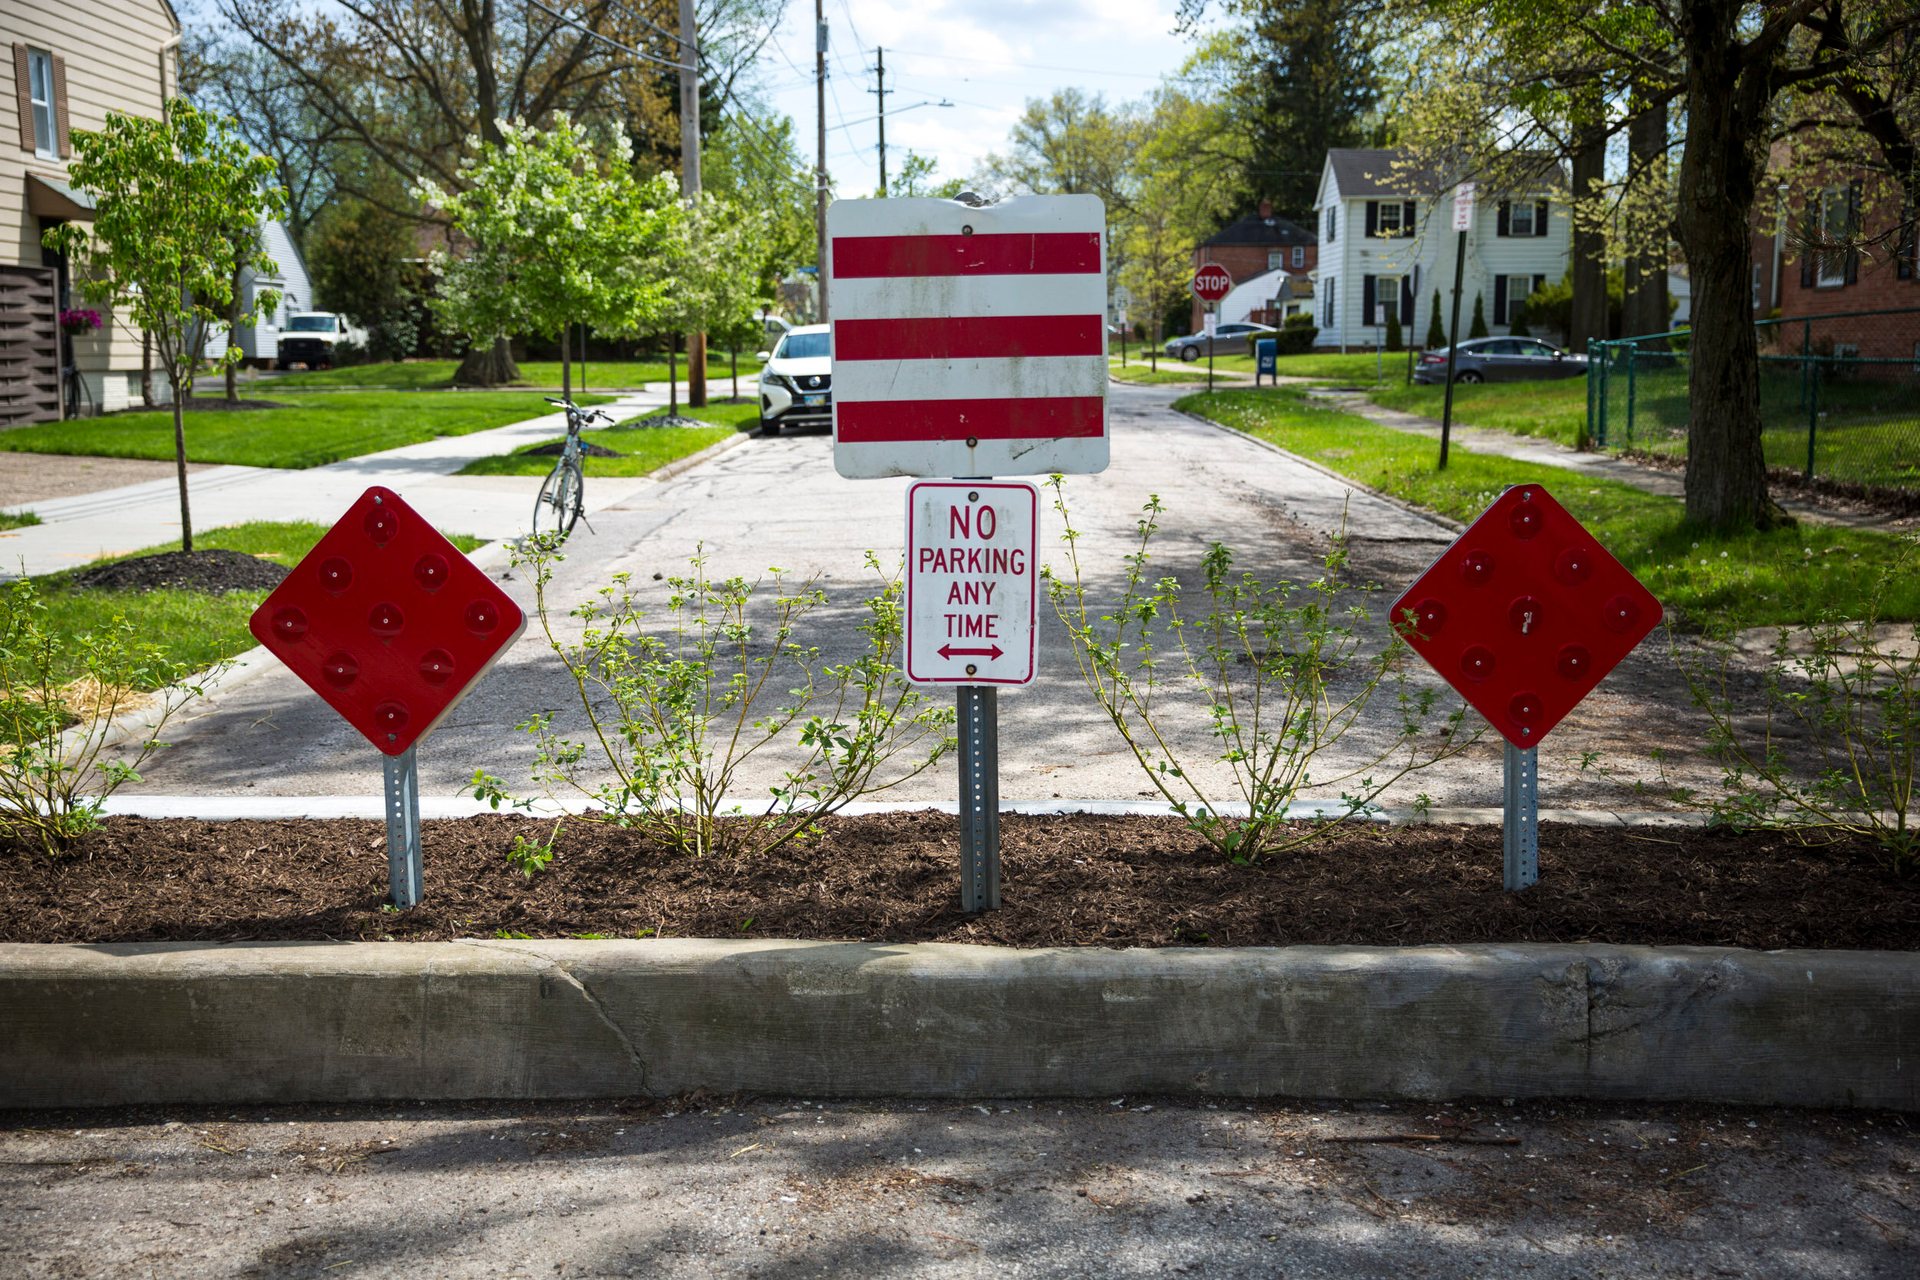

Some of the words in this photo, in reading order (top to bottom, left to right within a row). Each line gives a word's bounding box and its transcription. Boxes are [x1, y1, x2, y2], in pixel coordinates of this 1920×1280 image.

[1195, 275, 1228, 291] STOP
[950, 505, 996, 540] NO
[919, 548, 1025, 575] PARKING
[947, 581, 997, 605] ANY
[943, 614, 999, 638] TIME
